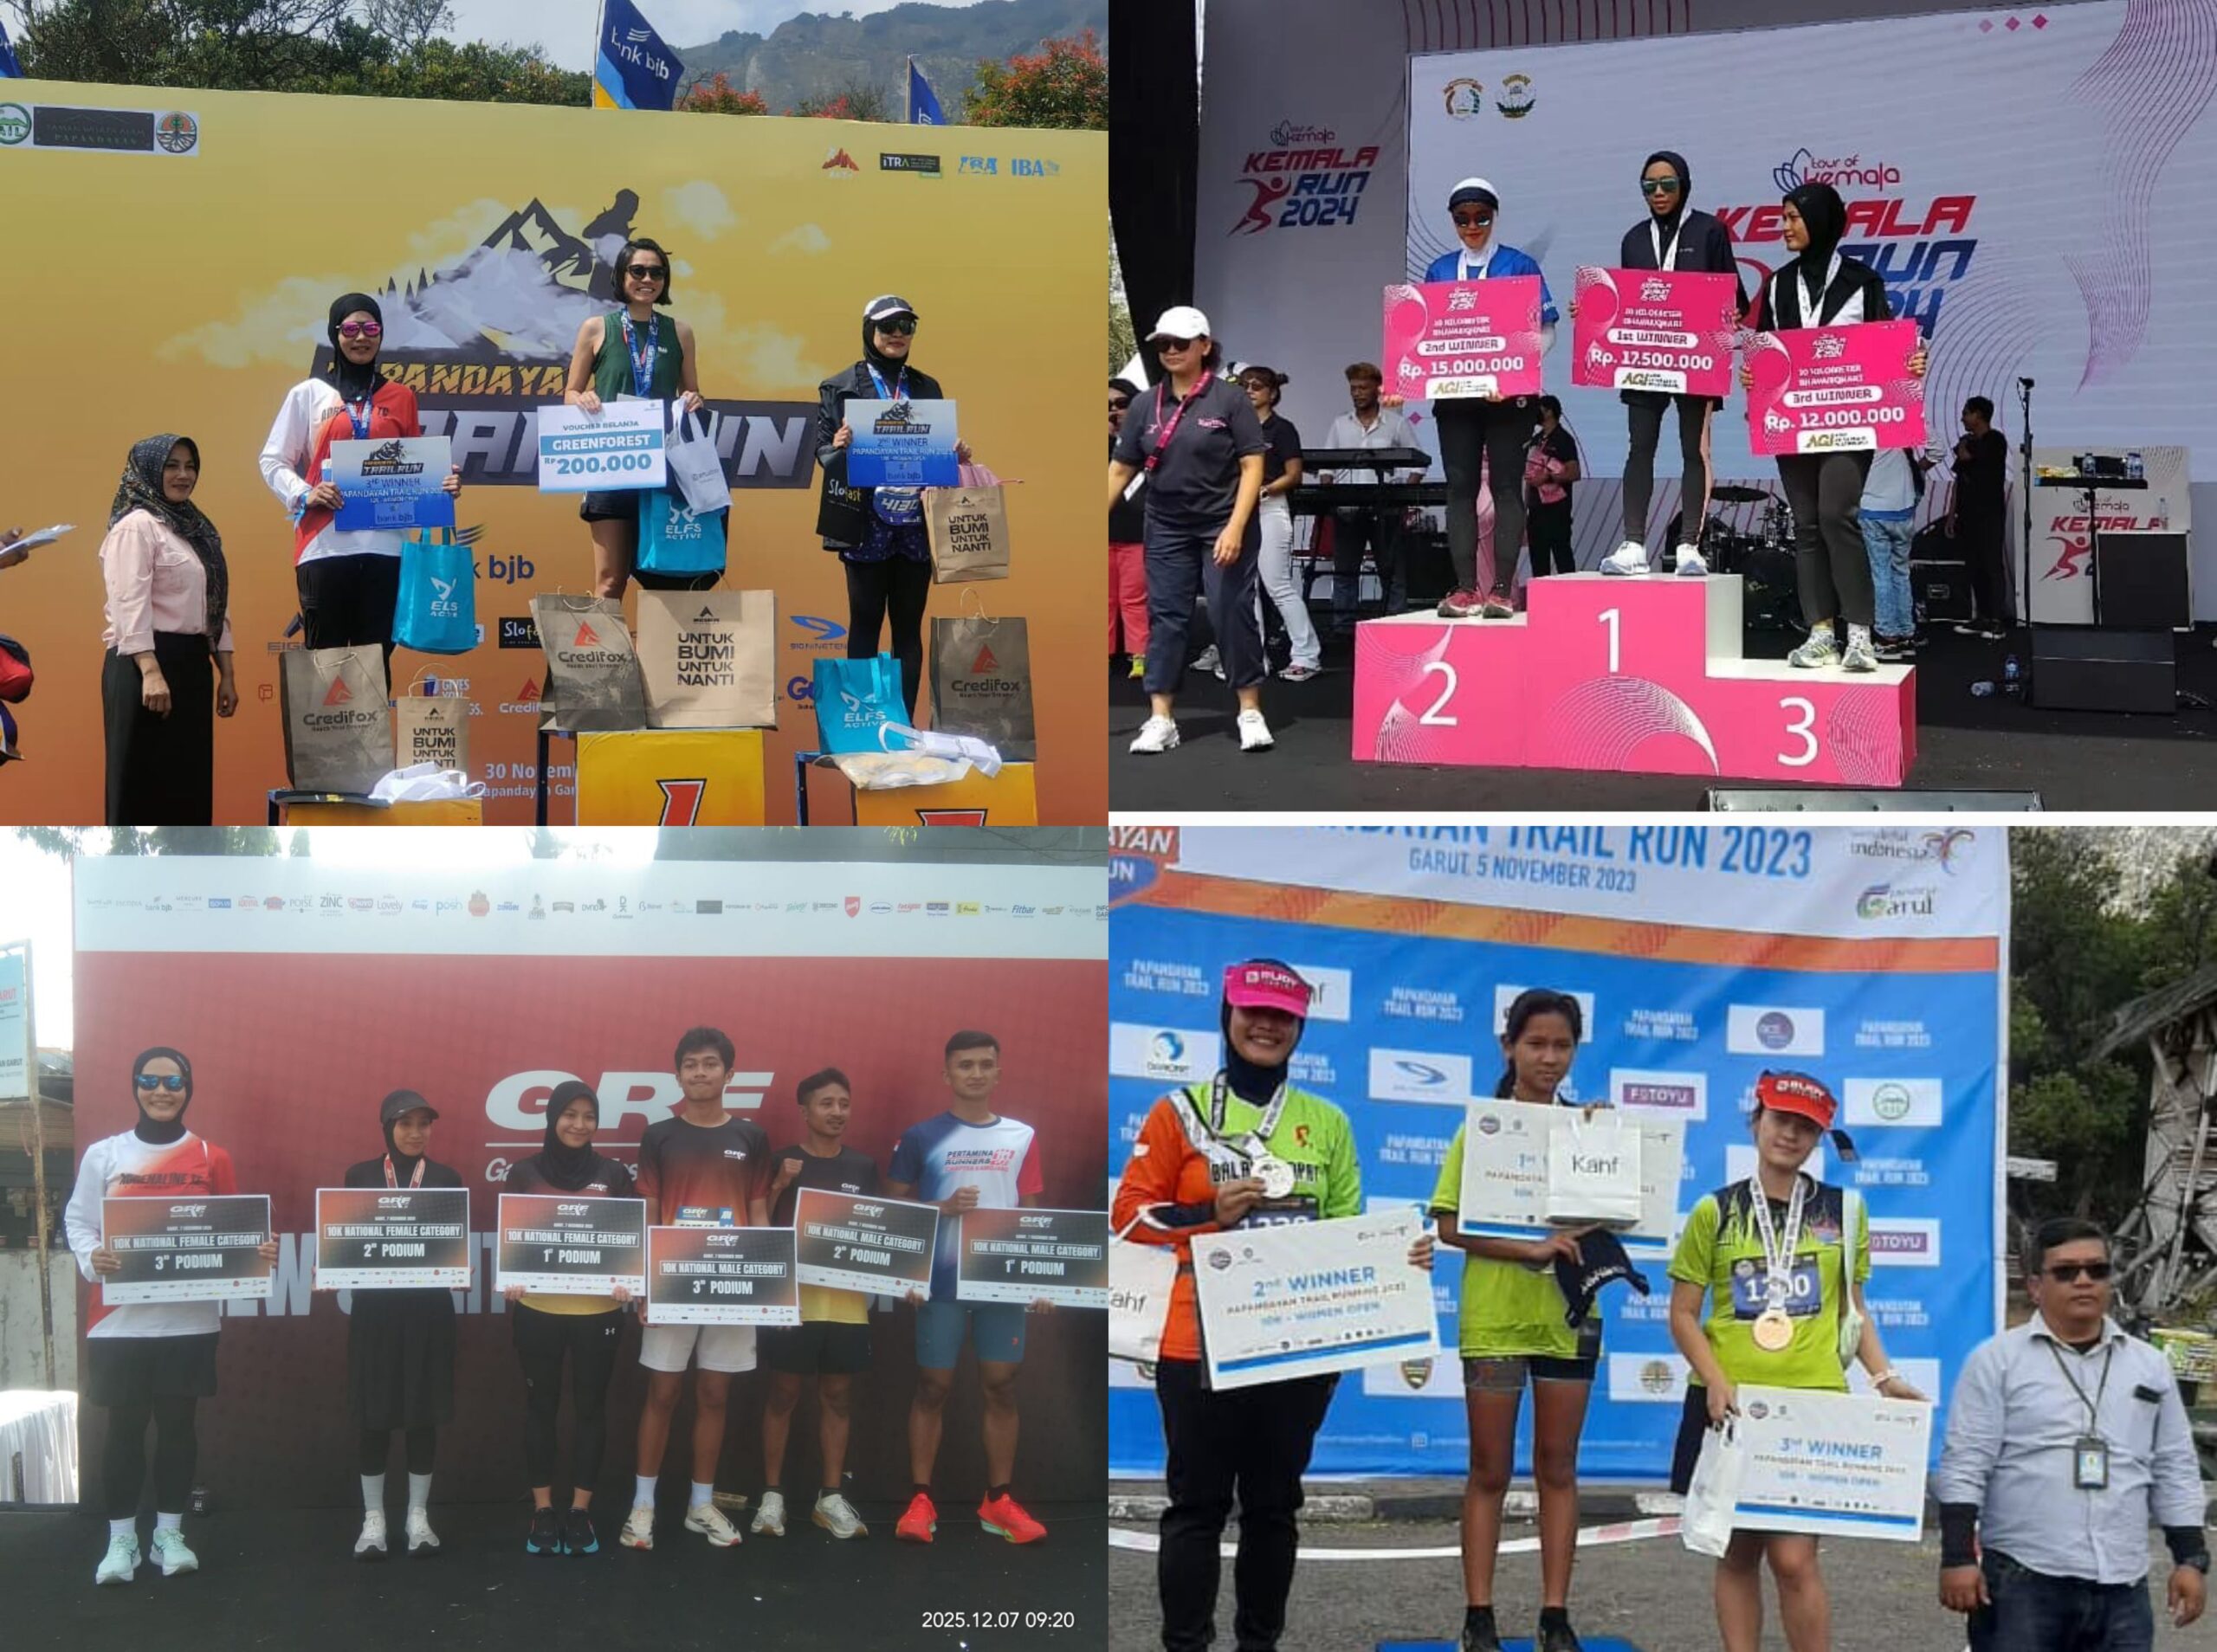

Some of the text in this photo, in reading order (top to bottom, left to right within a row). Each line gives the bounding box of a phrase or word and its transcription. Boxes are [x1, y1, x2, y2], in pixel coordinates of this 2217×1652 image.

[1243, 146, 1380, 173] KEMALA
[1812, 154, 1860, 170] tour of
[1293, 171, 1370, 196] RUN
[1278, 197, 1361, 228] 2024
[1716, 196, 1977, 242] KEALA
[1617, 331, 1688, 345] 1st WINNER
[1425, 339, 1499, 352] 2nd WINNER
[1590, 347, 1713, 371] Rp. 17.500.000
[1399, 356, 1524, 380] Rp. 15.000.000
[1793, 389, 1872, 403] 3rd WINNER
[563, 422, 600, 431] VOUCHER
[1765, 407, 1904, 432] Rp. 12.000.000
[553, 435, 651, 451] GREENFOREST
[893, 438, 928, 447] WINNER
[557, 454, 652, 475] 200.000
[949, 513, 987, 523] UNTUK
[666, 523, 701, 534] ELFS
[950, 523, 989, 534] BUMI
[951, 533, 989, 543] UNTUK
[953, 542, 992, 552] NANTI
[488, 555, 534, 584] bjb
[678, 633, 734, 644] UNTUK
[1598, 609, 1619, 672] 1
[558, 650, 626, 663] Credifox
[678, 645, 735, 660] BUMI
[678, 661, 734, 673] UNTUK
[678, 674, 734, 686] NANTI
[952, 679, 1020, 692] Credifox
[1419, 661, 1458, 726] 2
[303, 710, 378, 726] Credifox
[844, 711, 886, 723] ELFS
[413, 727, 455, 736] UNTUK
[1776, 697, 1818, 766] 3
[413, 737, 456, 748] BUMI
[413, 749, 455, 758] UNTUK
[486, 763, 507, 778] 30
[1721, 826, 1812, 879] 2023
[1477, 855, 1637, 894] 5 NOVEMBER 2023
[320, 896, 343, 908] ZINC
[1012, 905, 1036, 914] Fitbar
[327, 1226, 460, 1236] 10K NATIONAL FEMALE CATEGORY
[507, 1230, 636, 1245] 10K NATIONAL FEMALE CATEGORY
[808, 1225, 923, 1251] 10K NATIONAL MALE CATEGORY
[113, 1235, 261, 1249] 10K NATIONAL FEMALE CATEGORY
[382, 1243, 425, 1257] PODIUM
[973, 1242, 1098, 1257] 10K NATIONAL MALE CATEGORY
[176, 1254, 223, 1269] PODIUM
[559, 1250, 601, 1264] PODIUM
[850, 1249, 891, 1266] PODIUM
[662, 1262, 784, 1275] 10K NATIONAL MALE CATEGORY
[1020, 1261, 1064, 1275] PODIUM
[1287, 1265, 1375, 1292] WINNER
[710, 1281, 753, 1294] PODIUM
[1807, 1438, 1883, 1459] WINNER
